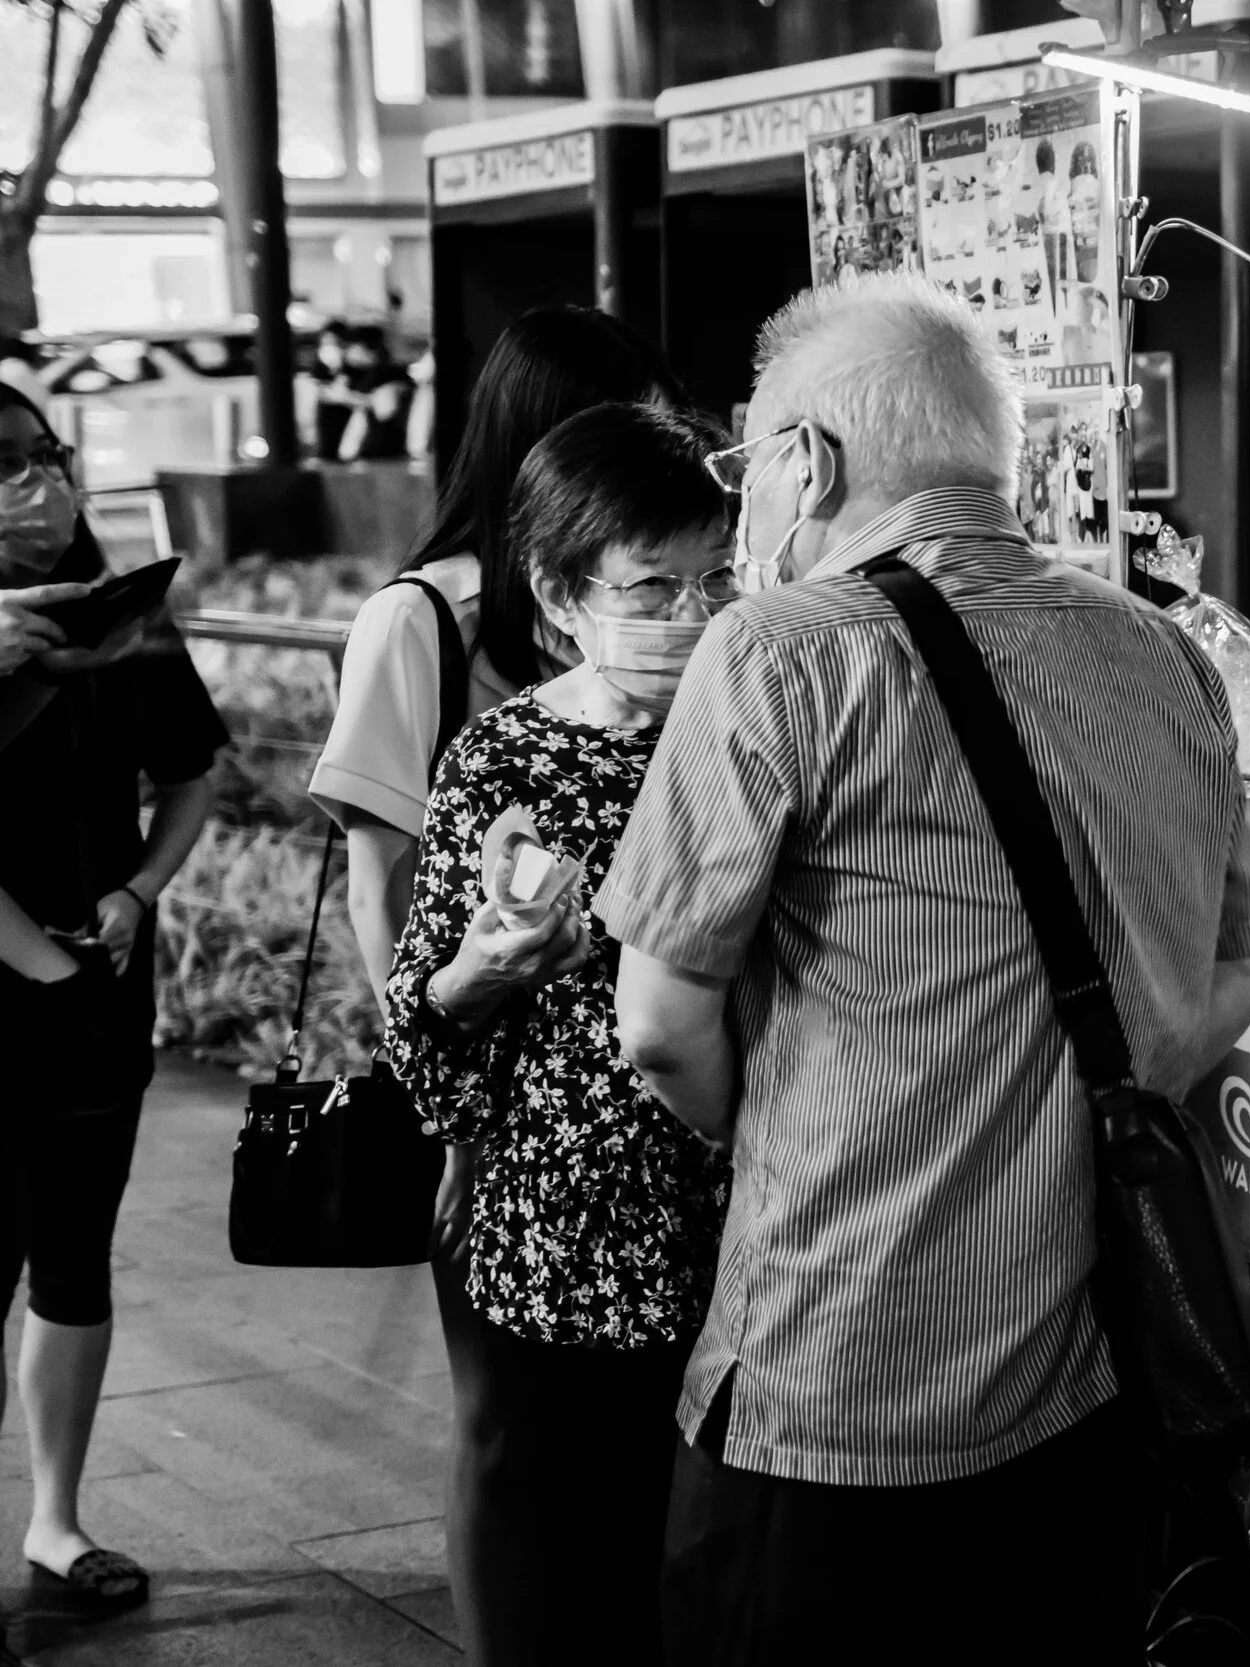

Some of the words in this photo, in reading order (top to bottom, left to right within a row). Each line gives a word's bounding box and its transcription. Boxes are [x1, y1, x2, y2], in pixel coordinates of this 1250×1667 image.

[721, 90, 865, 155] PAYPHONE
[987, 118, 1020, 142] $1.20
[475, 135, 586, 189] PAYPHONE
